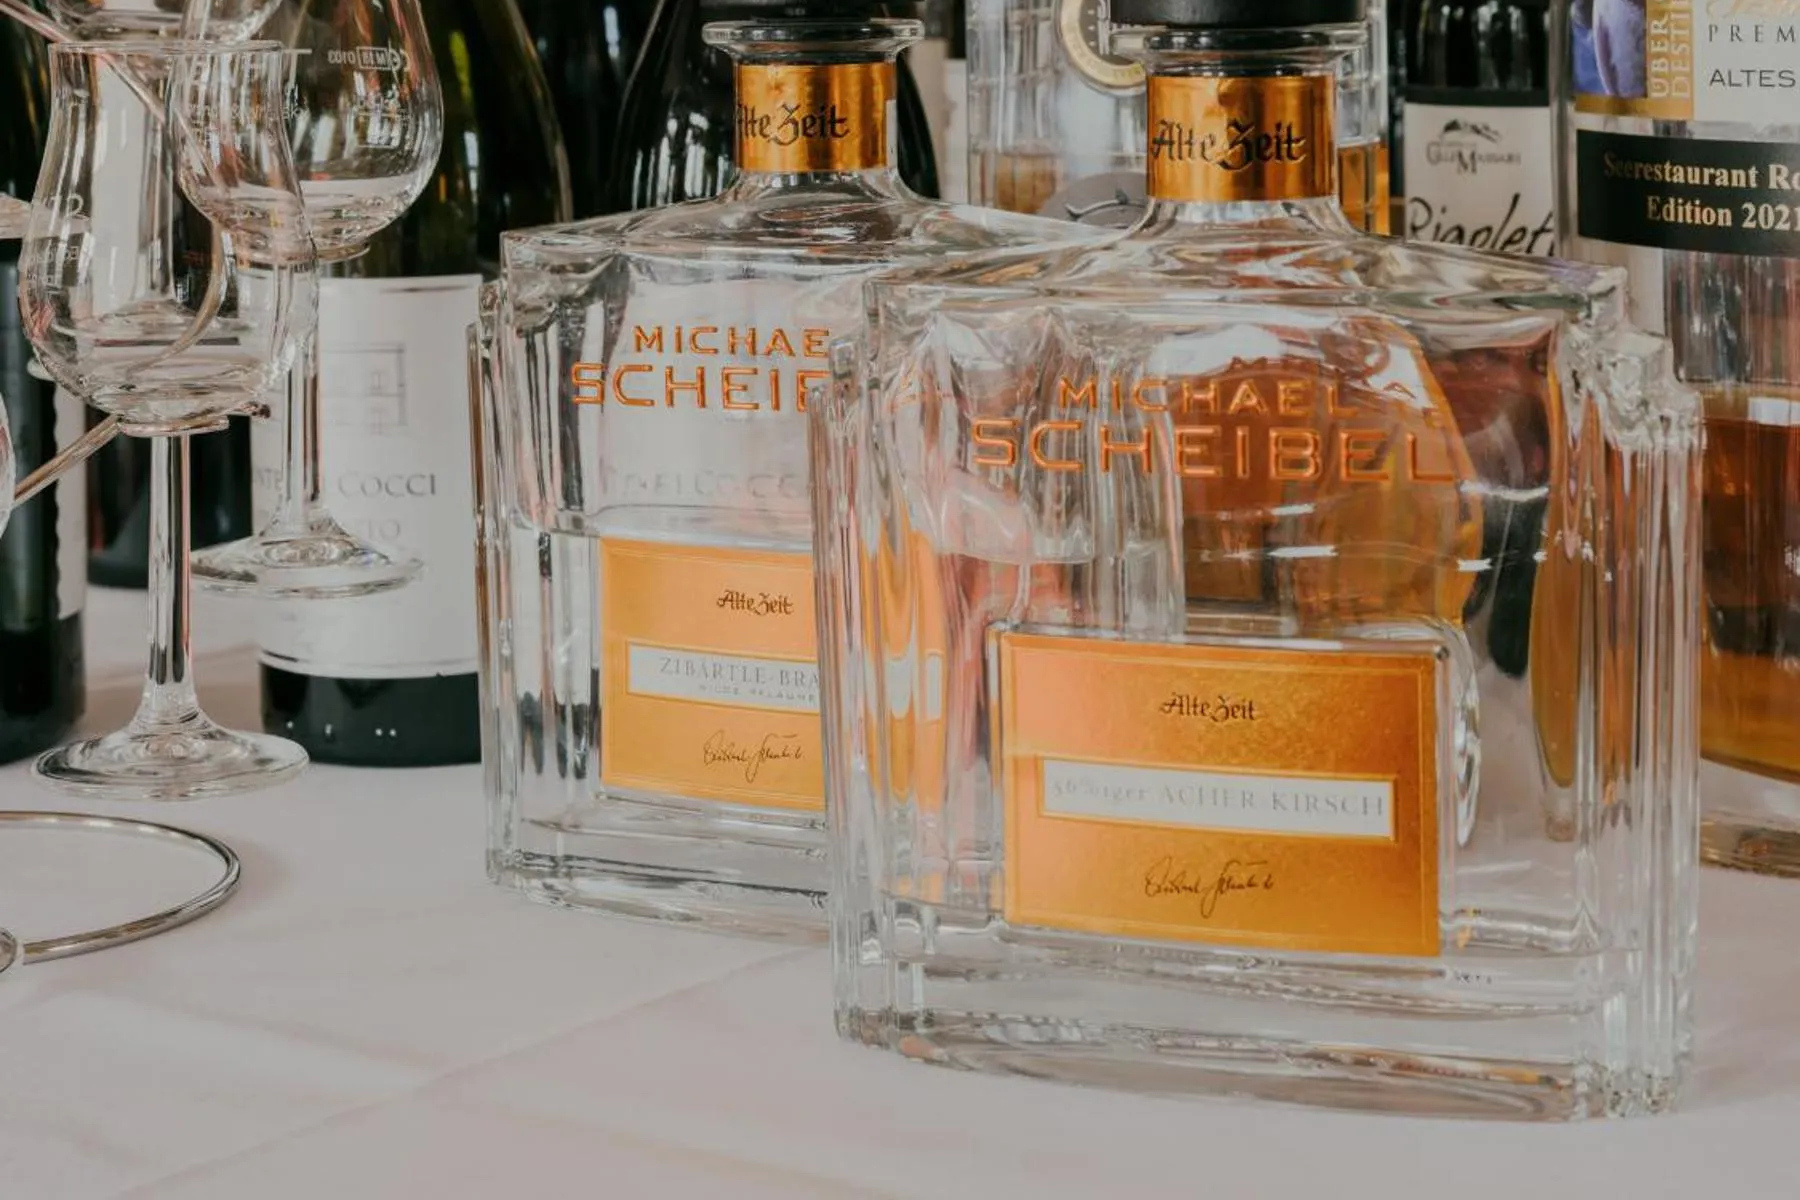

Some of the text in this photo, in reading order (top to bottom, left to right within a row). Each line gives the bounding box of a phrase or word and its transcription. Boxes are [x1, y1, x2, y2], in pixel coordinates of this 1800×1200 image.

[1709, 69, 1797, 88] ALTES
[767, 102, 850, 146] Zeit
[1151, 117, 1307, 171] Alte Zeit
[1603, 152, 1759, 189] Seerestaurant
[1646, 196, 1733, 227] Edition
[1058, 375, 1358, 418] MICHAEL
[971, 418, 1455, 484] SCHEIBEL
[338, 462, 437, 497] COCCI
[715, 588, 794, 617] Alte Zeit
[1159, 692, 1258, 723] Alte Zeit
[1271, 791, 1384, 816] KIRSCH
